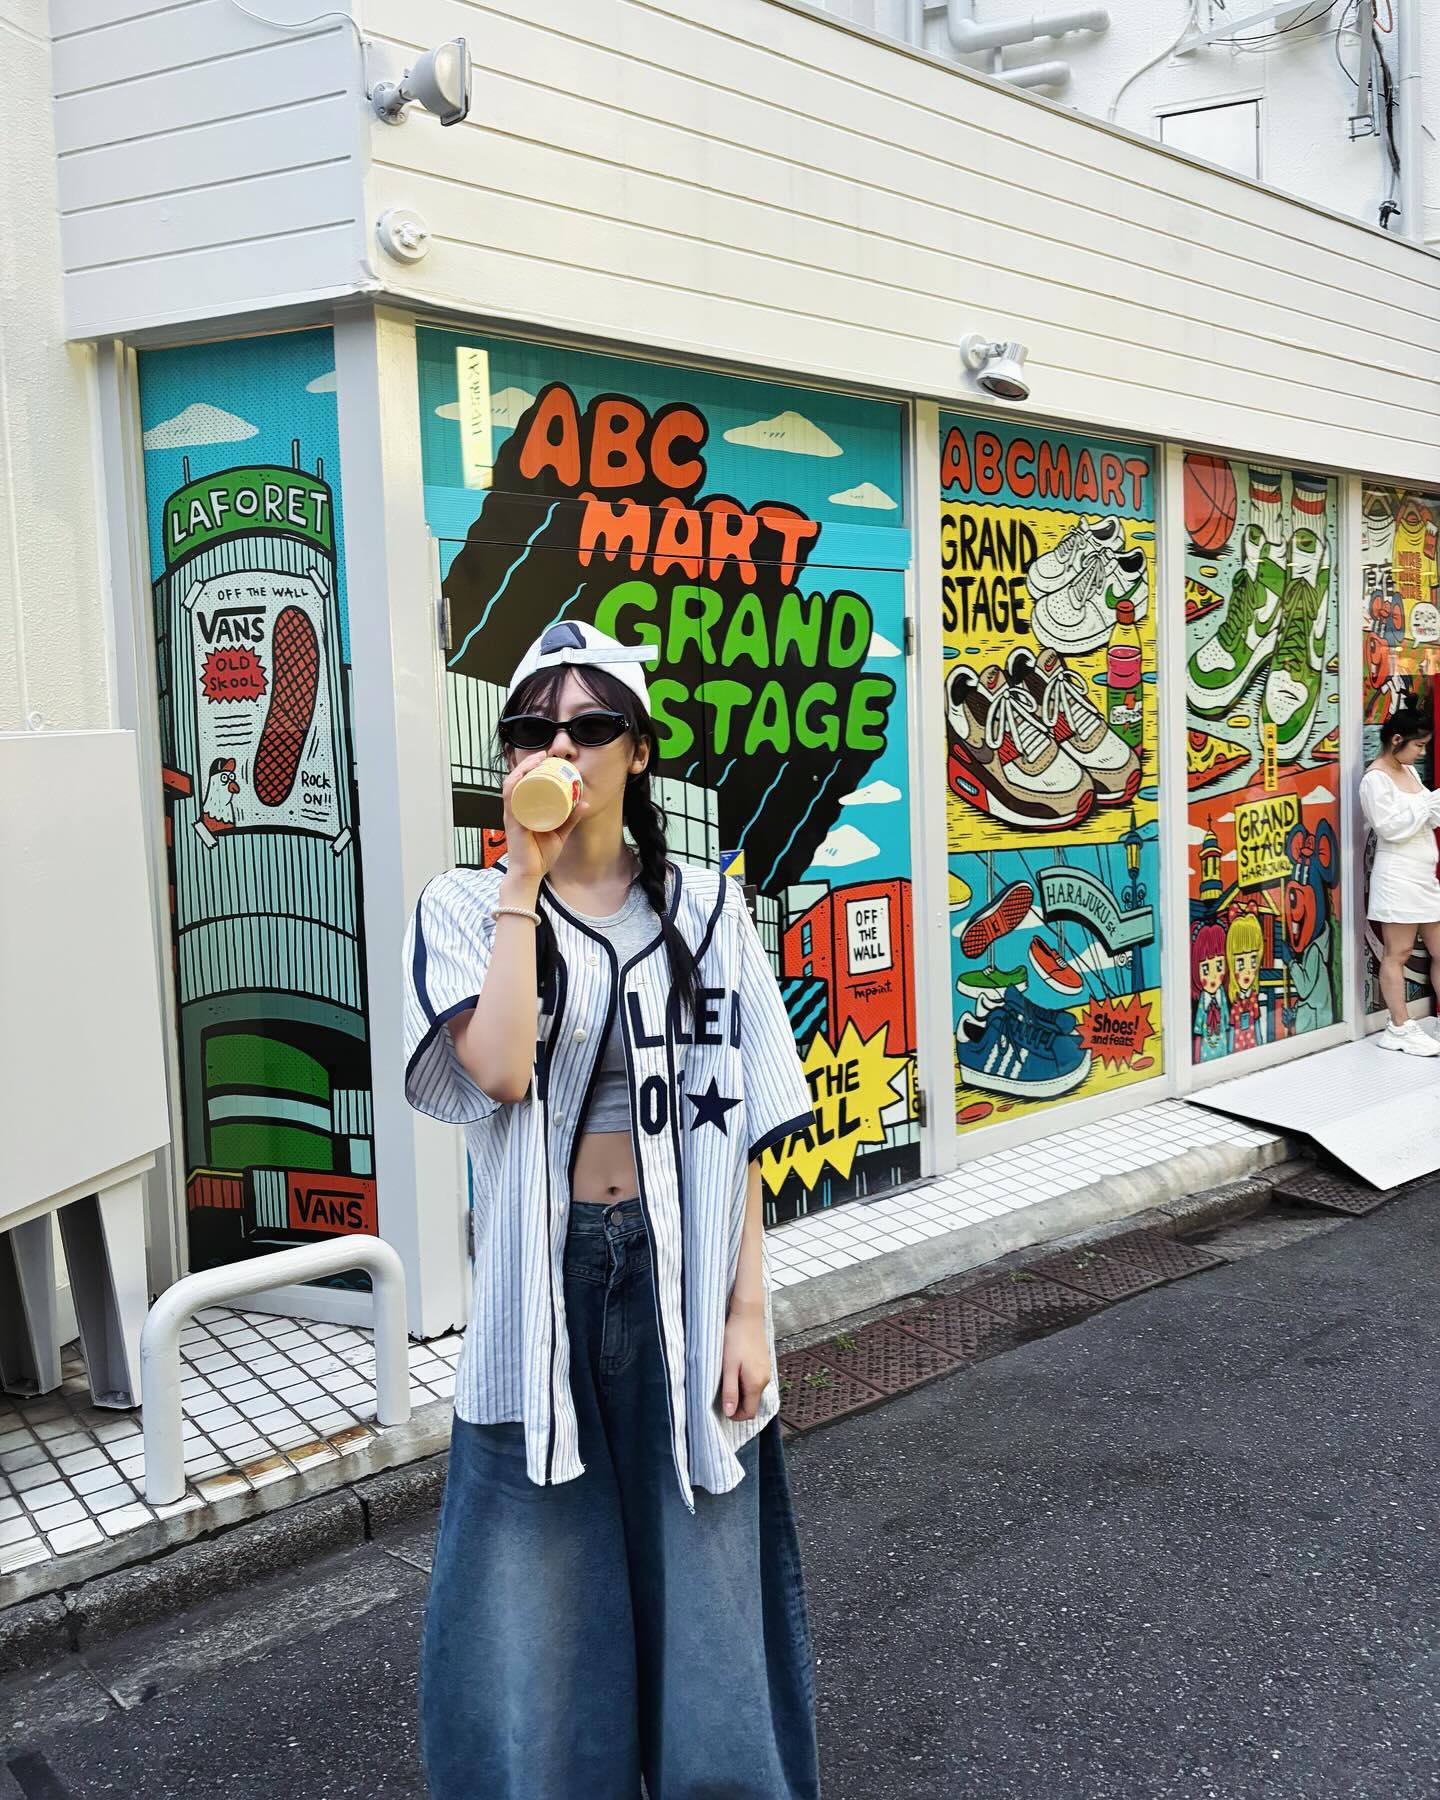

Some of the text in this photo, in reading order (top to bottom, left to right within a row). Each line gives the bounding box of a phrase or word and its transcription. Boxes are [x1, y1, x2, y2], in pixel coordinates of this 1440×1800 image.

[519, 387, 705, 489] ABC
[941, 427, 1149, 511] ABCMART
[172, 485, 328, 544] LAFORET
[577, 492, 818, 585] MART
[941, 514, 1038, 575] GRAND
[217, 586, 309, 601] OFF THE WALL
[942, 576, 1032, 637] STAGE
[197, 605, 267, 644] VANS
[594, 580, 871, 671] GRAND
[215, 656, 251, 671] OLD
[649, 679, 893, 760] STAGE
[303, 793, 332, 808] ON!!
[1238, 800, 1296, 842] GRAND
[1240, 831, 1290, 867] STAG
[855, 909, 878, 927] OFF
[1046, 882, 1111, 924] HARAJUKU
[853, 942, 886, 962] WALL
[858, 926, 878, 943] THE
[1092, 1012, 1140, 1036] Shoes!
[805, 1058, 861, 1103] THE
